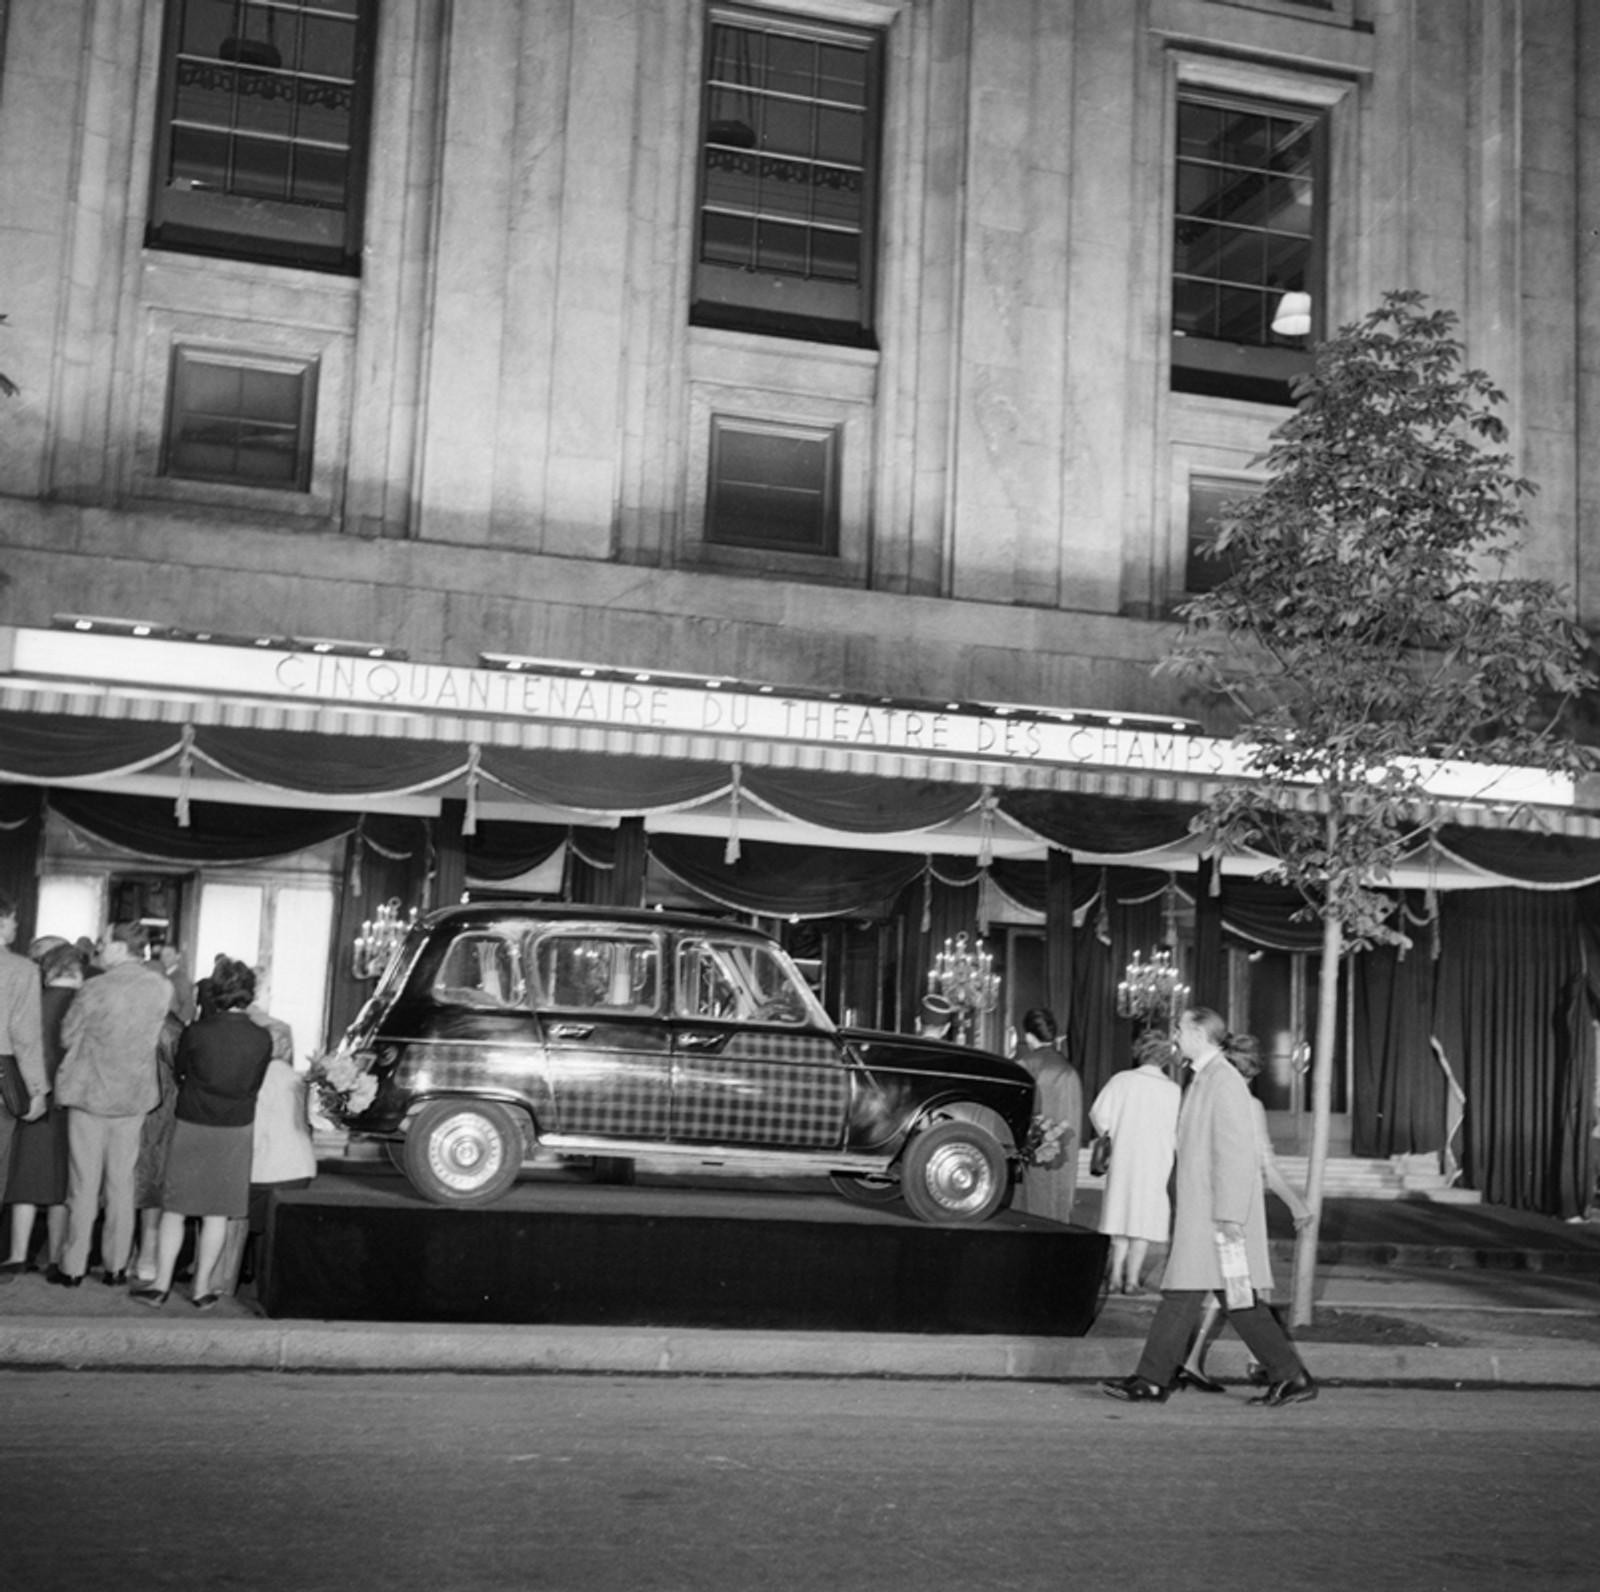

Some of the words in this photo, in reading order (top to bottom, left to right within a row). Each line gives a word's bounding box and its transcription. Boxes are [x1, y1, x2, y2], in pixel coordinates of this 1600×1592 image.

[276, 655, 668, 725] CINQUANTENAIRE
[702, 692, 749, 732] DU
[781, 701, 948, 748] THEATRE
[977, 717, 1041, 760] DES
